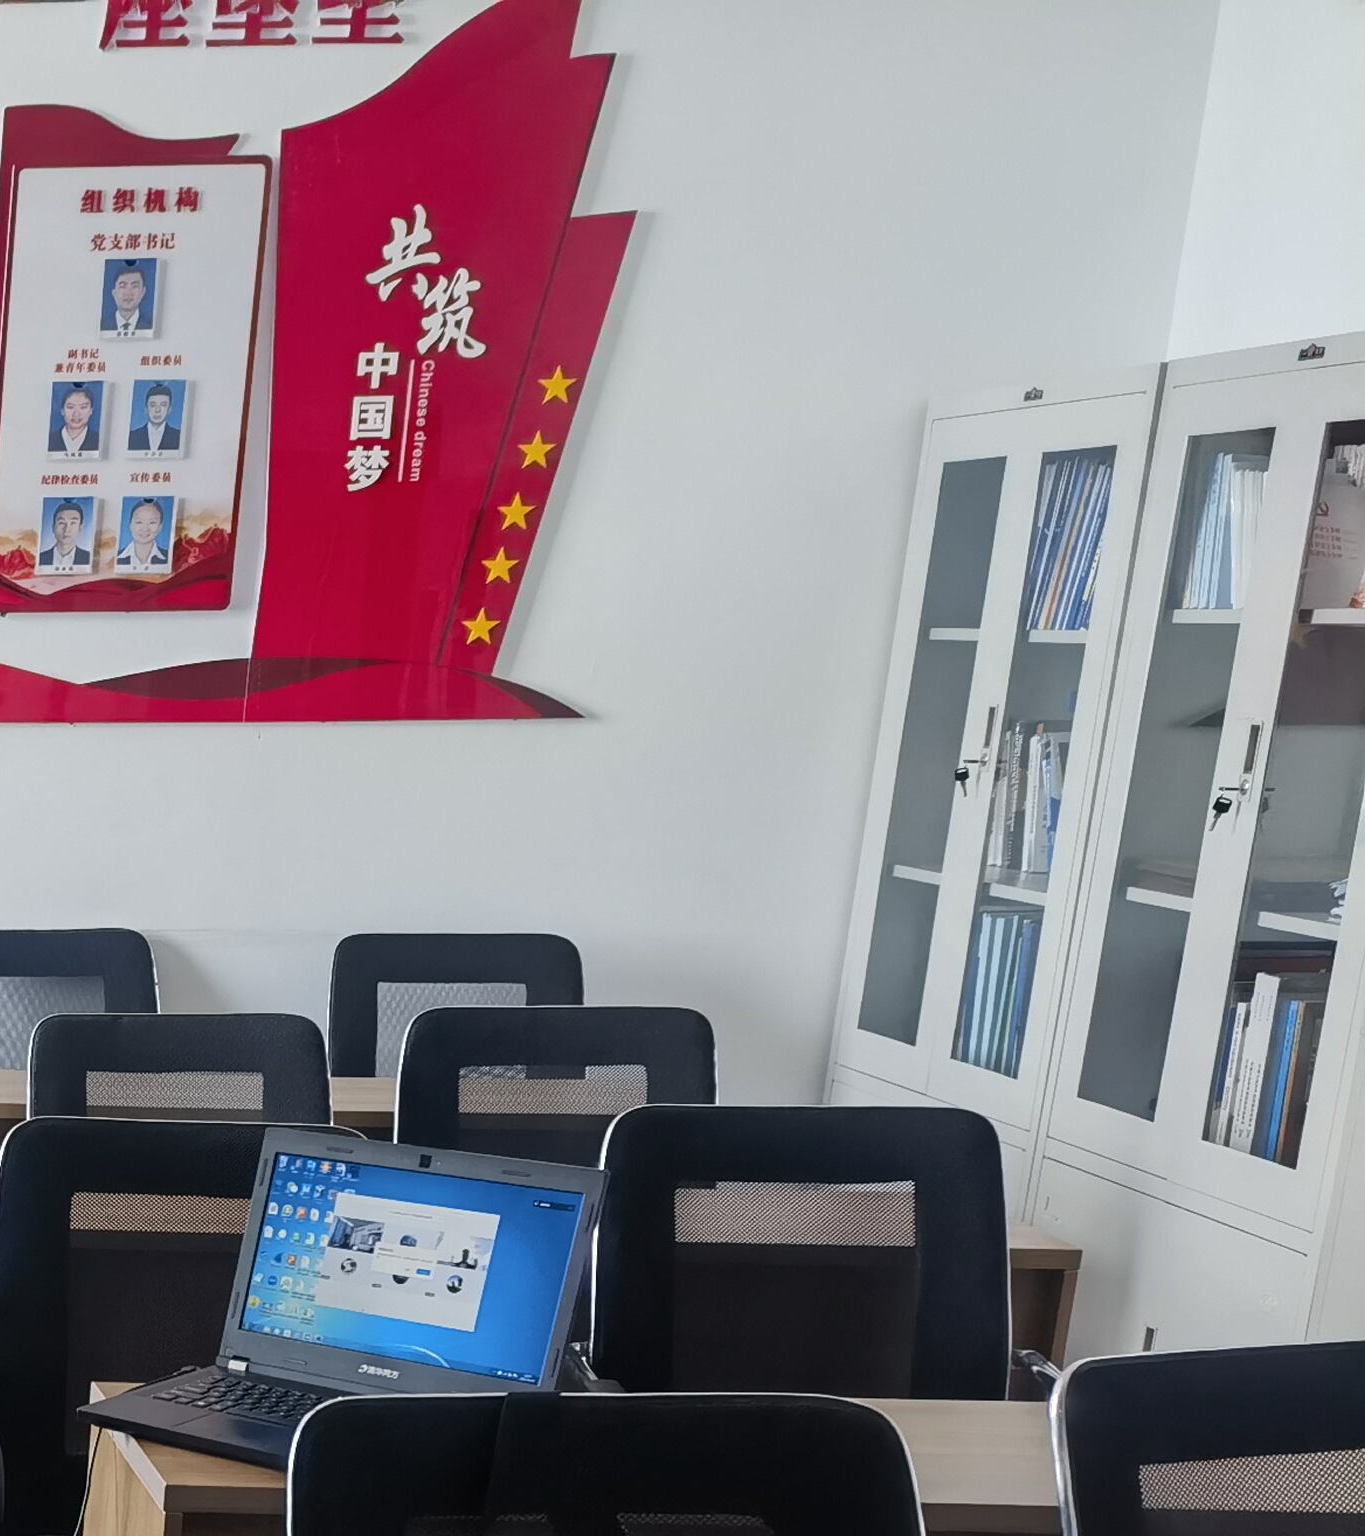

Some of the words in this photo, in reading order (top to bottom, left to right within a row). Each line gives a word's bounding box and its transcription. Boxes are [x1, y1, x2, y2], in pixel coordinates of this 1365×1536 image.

[80, 187, 201, 213] 组织机构
[91, 233, 175, 251] 党支部书记
[365, 203, 486, 358] 共筑
[68, 349, 99, 359] 副书记
[140, 355, 182, 366] 组织委员
[416, 360, 435, 428] Chinese
[344, 342, 400, 492] 中国梦
[409, 432, 426, 482] dream
[41, 474, 99, 485] 纪律检查委员
[130, 472, 172, 483] 宣传委员
